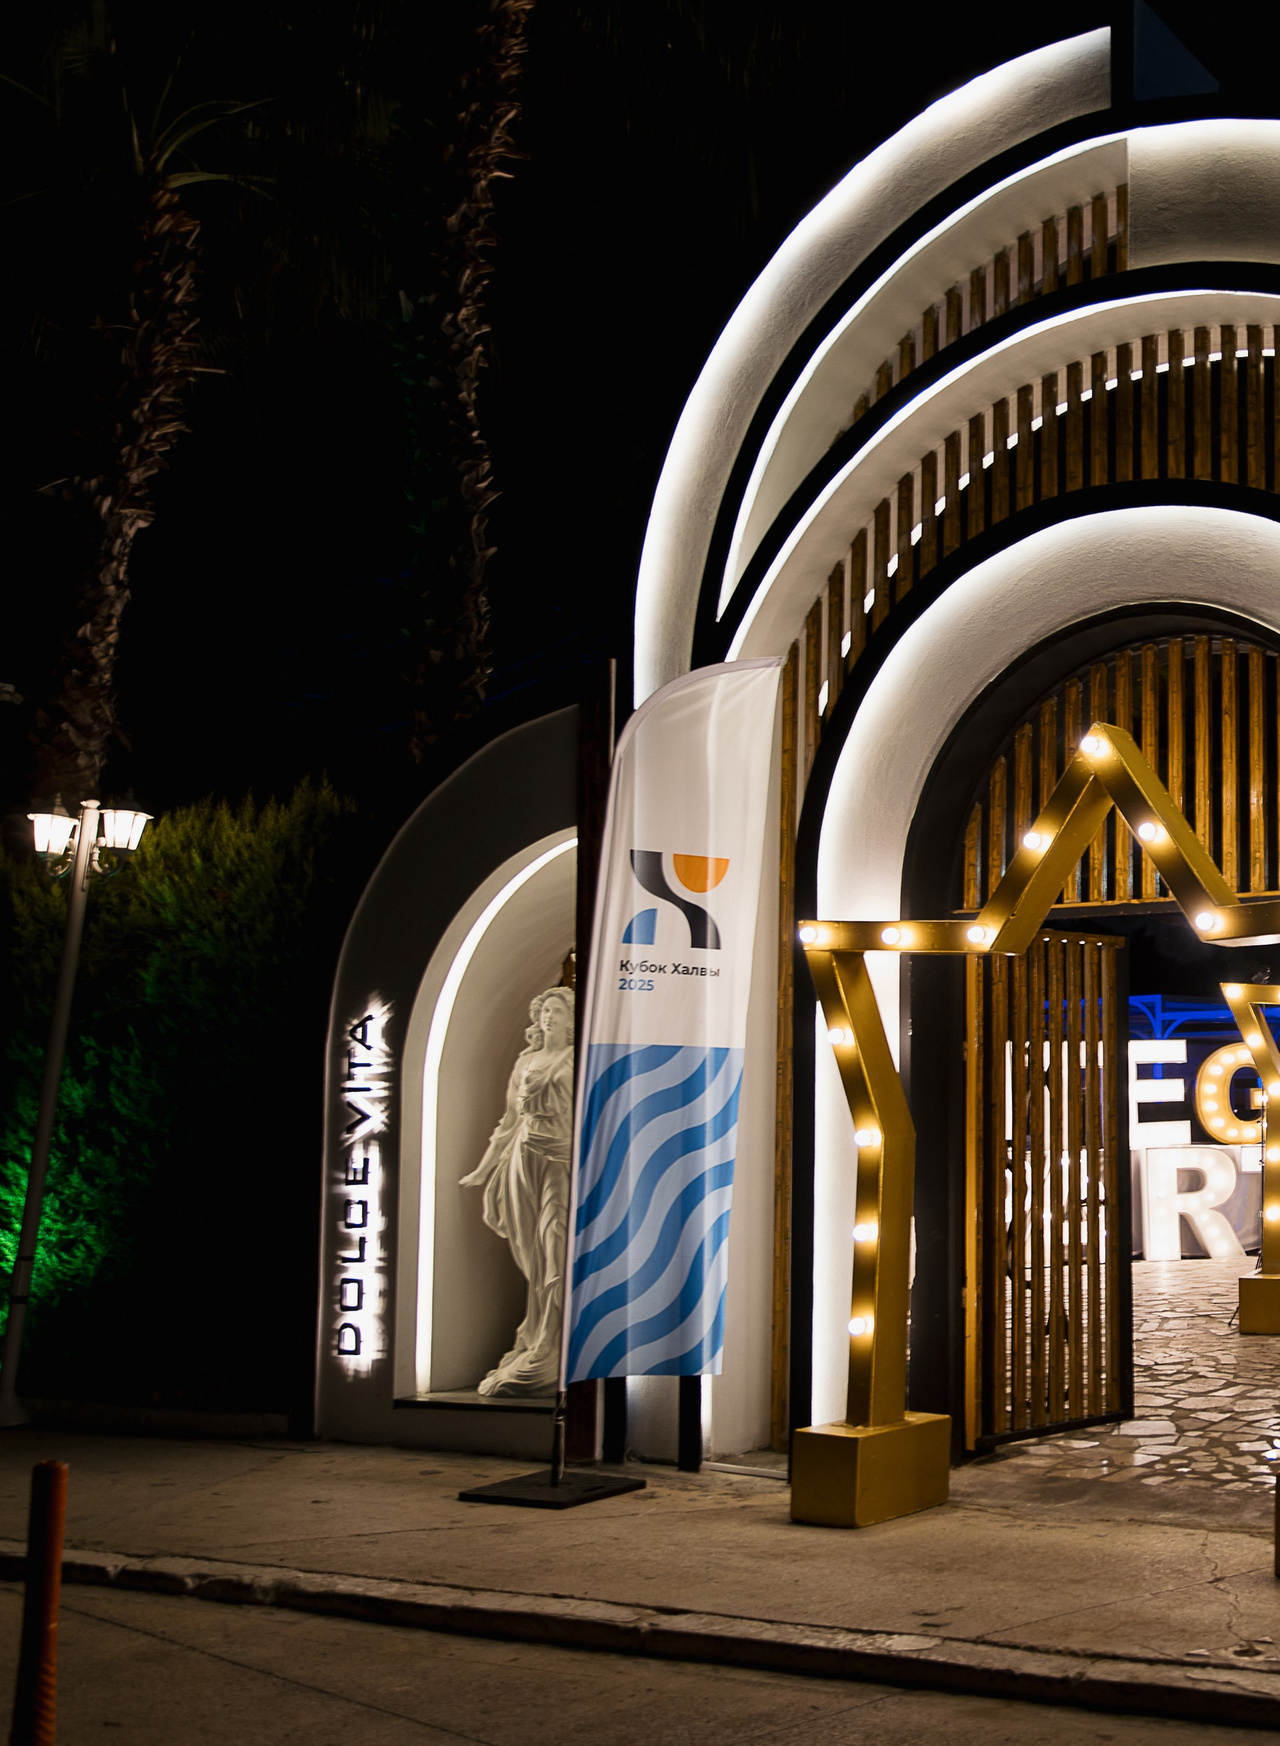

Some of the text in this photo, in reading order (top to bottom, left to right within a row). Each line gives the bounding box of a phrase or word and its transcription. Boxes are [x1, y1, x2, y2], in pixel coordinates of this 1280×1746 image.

[619, 960, 720, 977] Кубок Халвы
[618, 978, 654, 991] 2025
[337, 1014, 374, 1356] DOLCE VITA
